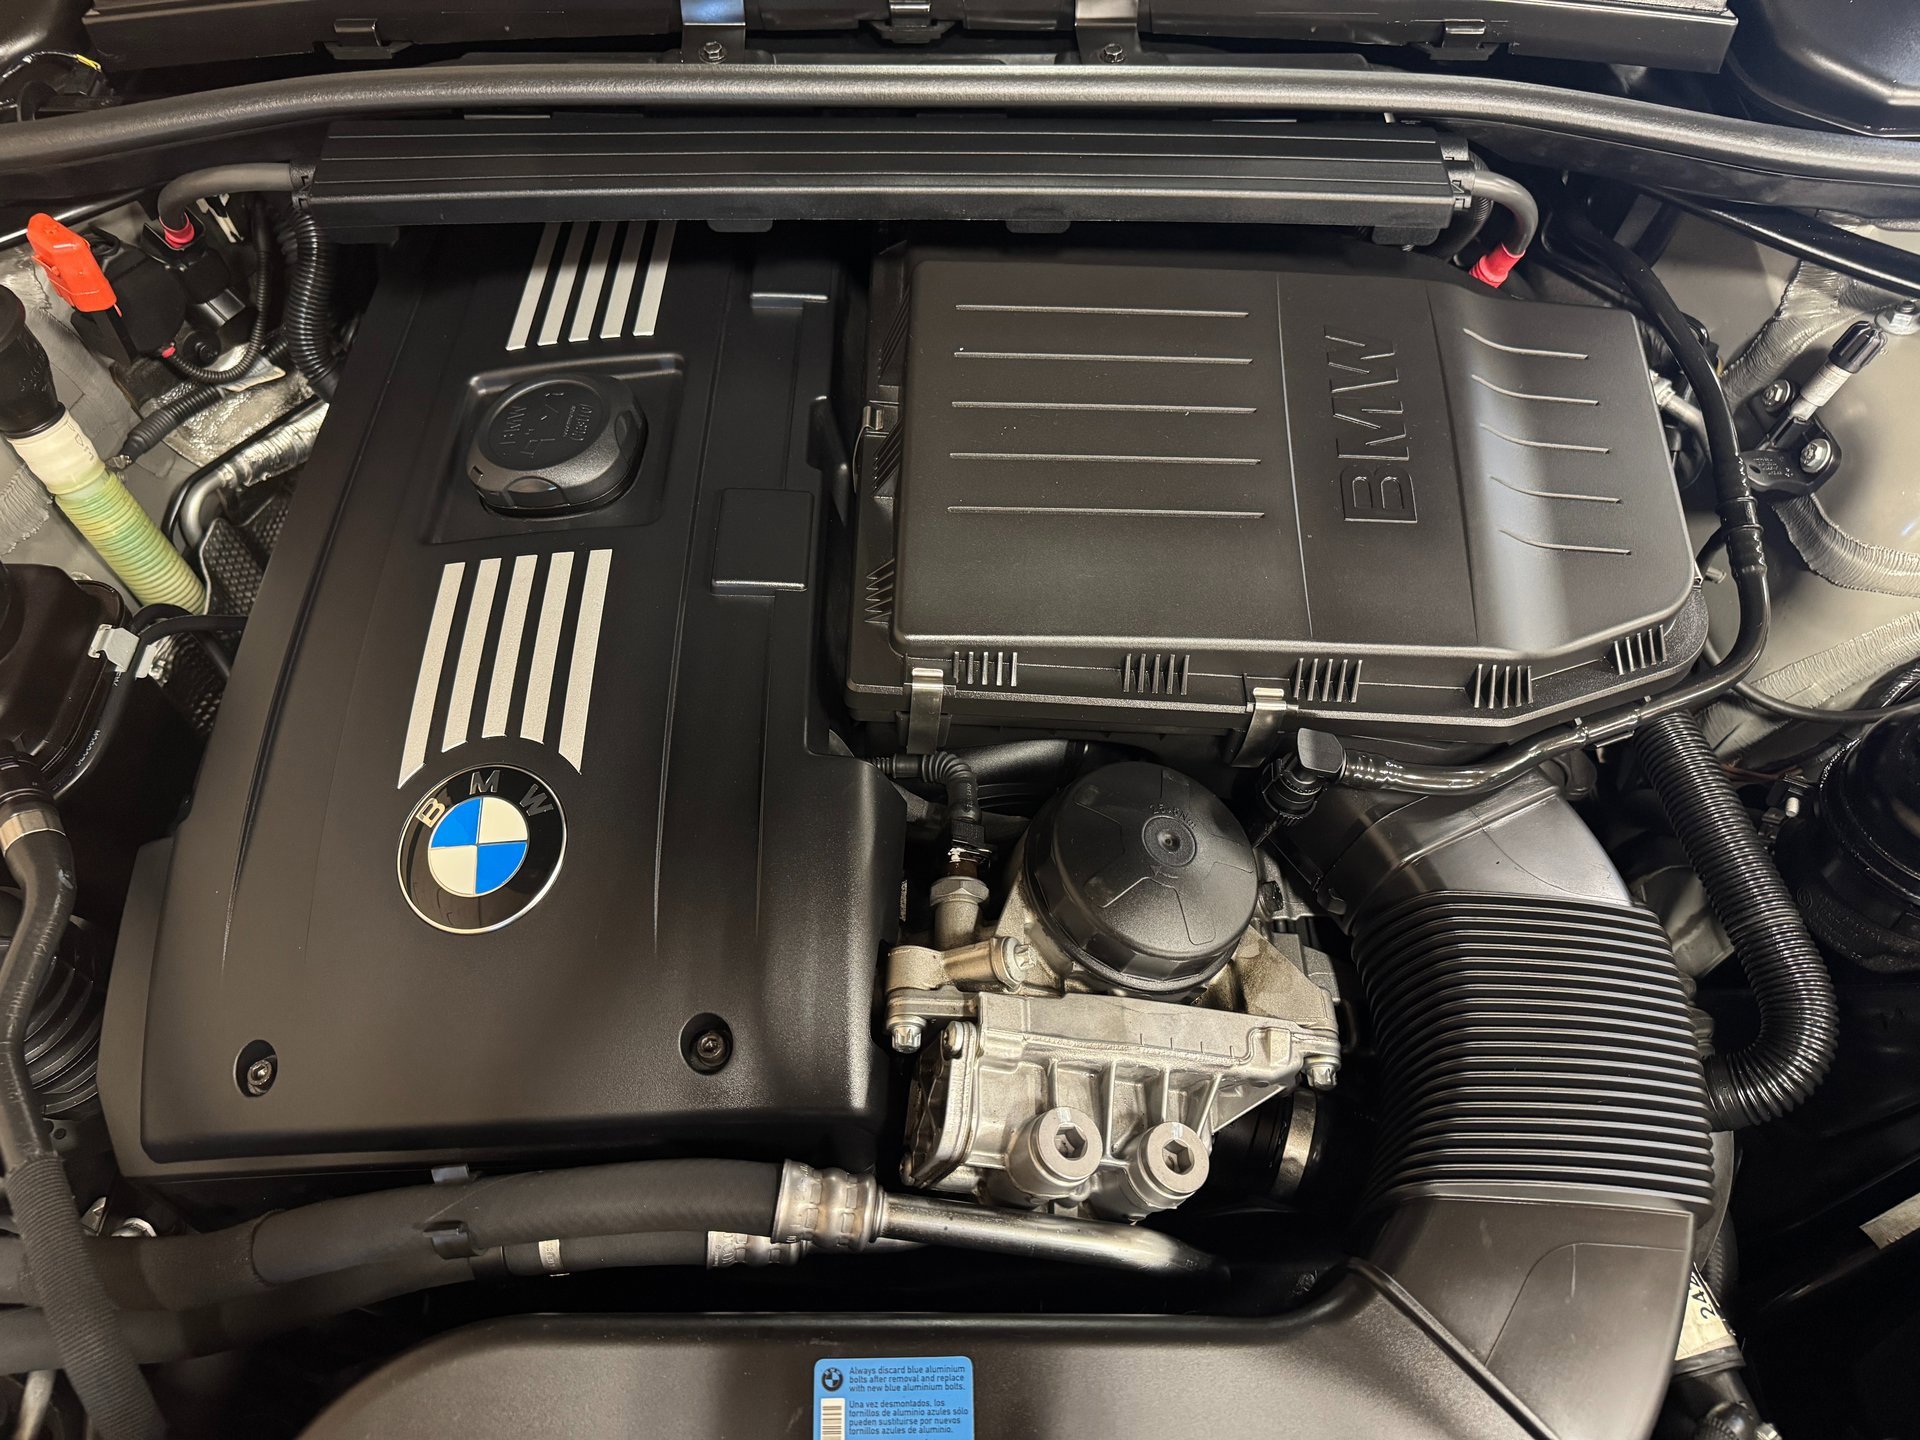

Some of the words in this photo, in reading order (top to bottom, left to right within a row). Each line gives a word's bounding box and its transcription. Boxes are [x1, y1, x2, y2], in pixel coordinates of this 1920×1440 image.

[498, 405, 528, 445] BMW
[1324, 325, 1418, 523] BMW
[416, 770, 554, 828] BMW
[849, 1367, 876, 1377] Always
[878, 1366, 906, 1374] discard
[907, 1365, 923, 1374] blue
[925, 1365, 966, 1373] aluminium
[849, 1376, 868, 1384] bolts
[869, 1375, 887, 1383] after
[888, 1374, 919, 1383] removal
[920, 1374, 935, 1382] and
[937, 1374, 965, 1385] replace
[849, 1384, 865, 1392] with
[884, 1383, 901, 1392] blue
[902, 1383, 943, 1391] aluminium
[945, 1382, 966, 1391] bolts.
[849, 1400, 864, 1408] Una
[934, 1399, 945, 1407] los
[849, 1409, 880, 1417] tornillos
[881, 1408, 891, 1417] de
[892, 1408, 925, 1416] aluminio
[927, 1407, 951, 1416] azules
[952, 1406, 969, 1415] sólo
[849, 1418, 877, 1427] pueden
[879, 1417, 918, 1426] sustituirse
[920, 1418, 932, 1426] por
[934, 1417, 961, 1425] nuevos
[849, 1427, 880, 1435] tornillos
[881, 1426, 906, 1434] azules
[907, 1425, 917, 1434] de
[919, 1425, 953, 1434] aluminio.
